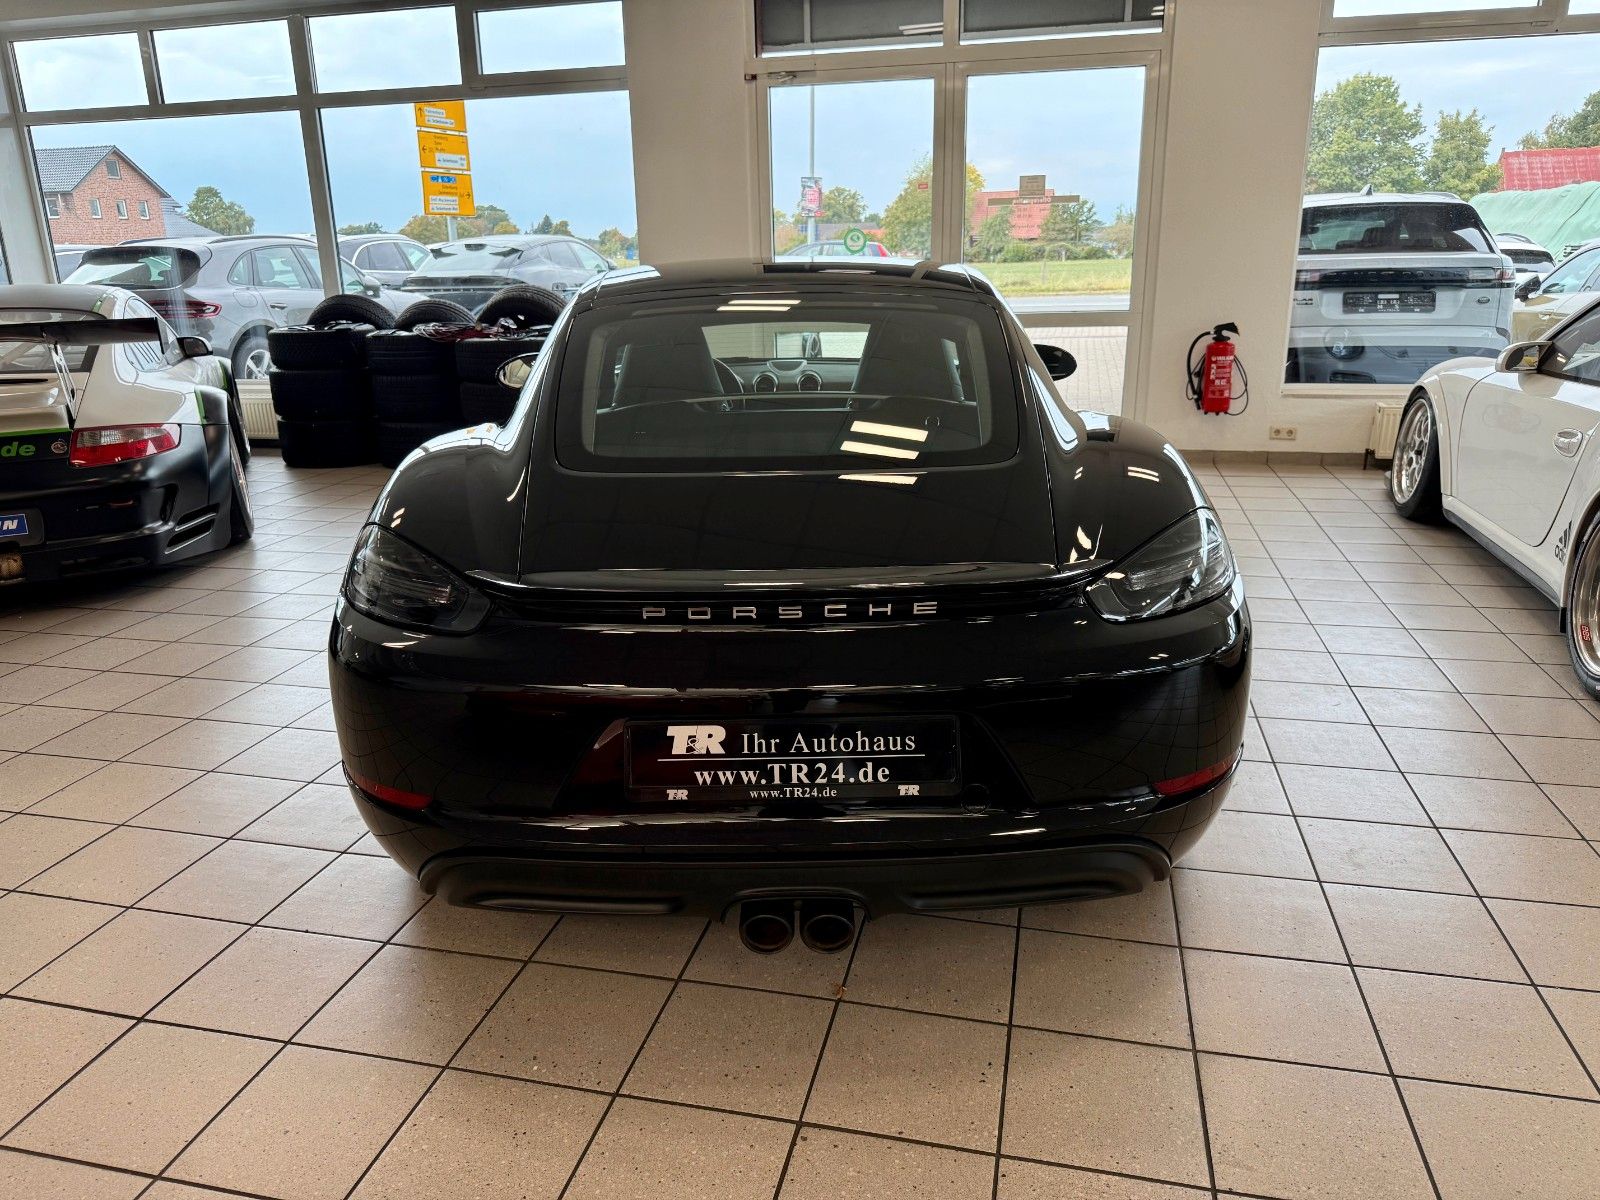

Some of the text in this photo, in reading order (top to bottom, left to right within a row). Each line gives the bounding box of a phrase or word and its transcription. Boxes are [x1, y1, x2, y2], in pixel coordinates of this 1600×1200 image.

[642, 601, 938, 620] PORSCHE
[666, 724, 916, 755] T&R Ihr Autohaus
[694, 761, 890, 786] www.TR24.de
[749, 787, 838, 799] www.TR24.de
